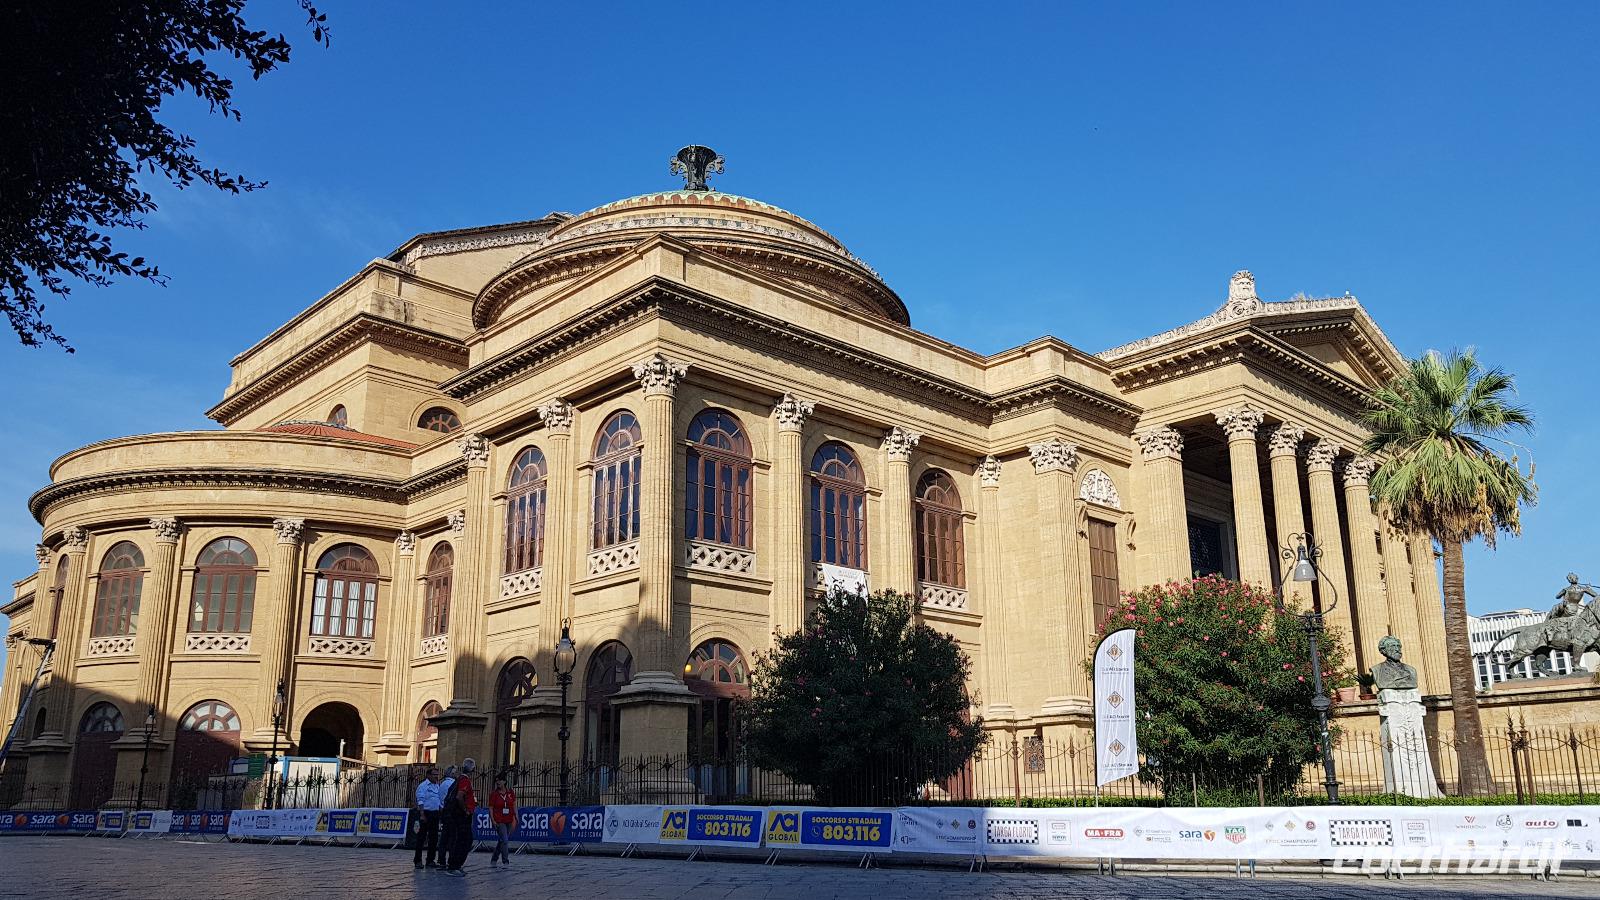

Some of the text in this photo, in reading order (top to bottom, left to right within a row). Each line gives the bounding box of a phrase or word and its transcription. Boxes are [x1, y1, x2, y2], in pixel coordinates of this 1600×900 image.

[31, 814, 56, 824] sara
[72, 814, 94, 824] sara
[172, 815, 184, 825] sara
[211, 815, 223, 826] sara
[520, 813, 548, 829] sara
[571, 812, 603, 830] sara
[663, 811, 687, 830] ACI
[770, 813, 798, 833] ACI
[704, 822, 751, 837] 803.116
[823, 825, 880, 842] 803.116
[994, 826, 1033, 838] TARGA FLORIO
[1179, 829, 1202, 839] sara
[1338, 827, 1385, 839] TARGA FLORIO
[768, 834, 797, 842] GLOBAL
